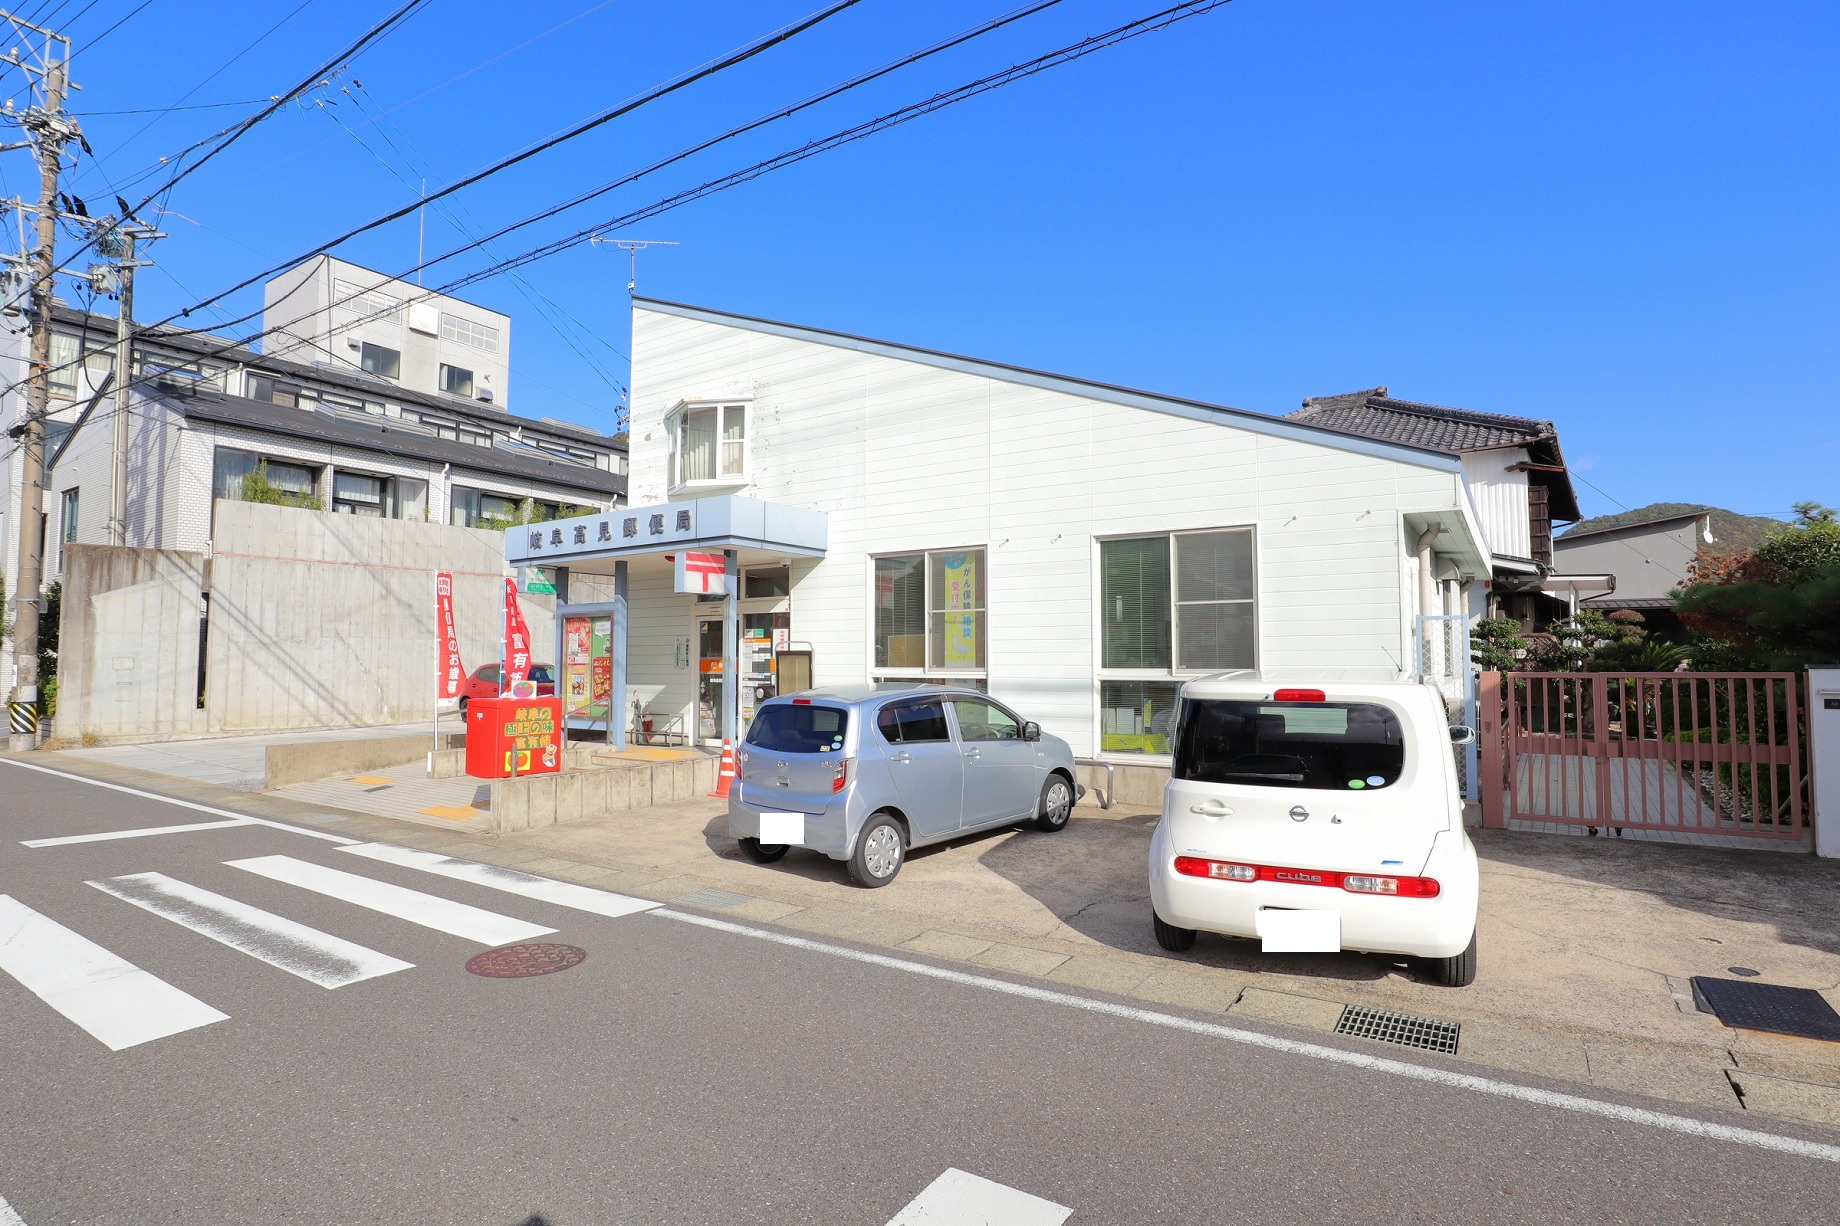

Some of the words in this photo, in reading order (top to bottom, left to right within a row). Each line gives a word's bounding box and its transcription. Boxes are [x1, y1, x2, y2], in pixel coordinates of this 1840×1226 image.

[529, 510, 692, 550] 岐阜高見郵便局
[505, 721, 553, 736] 極上の味
[1276, 872, 1321, 882] cube
